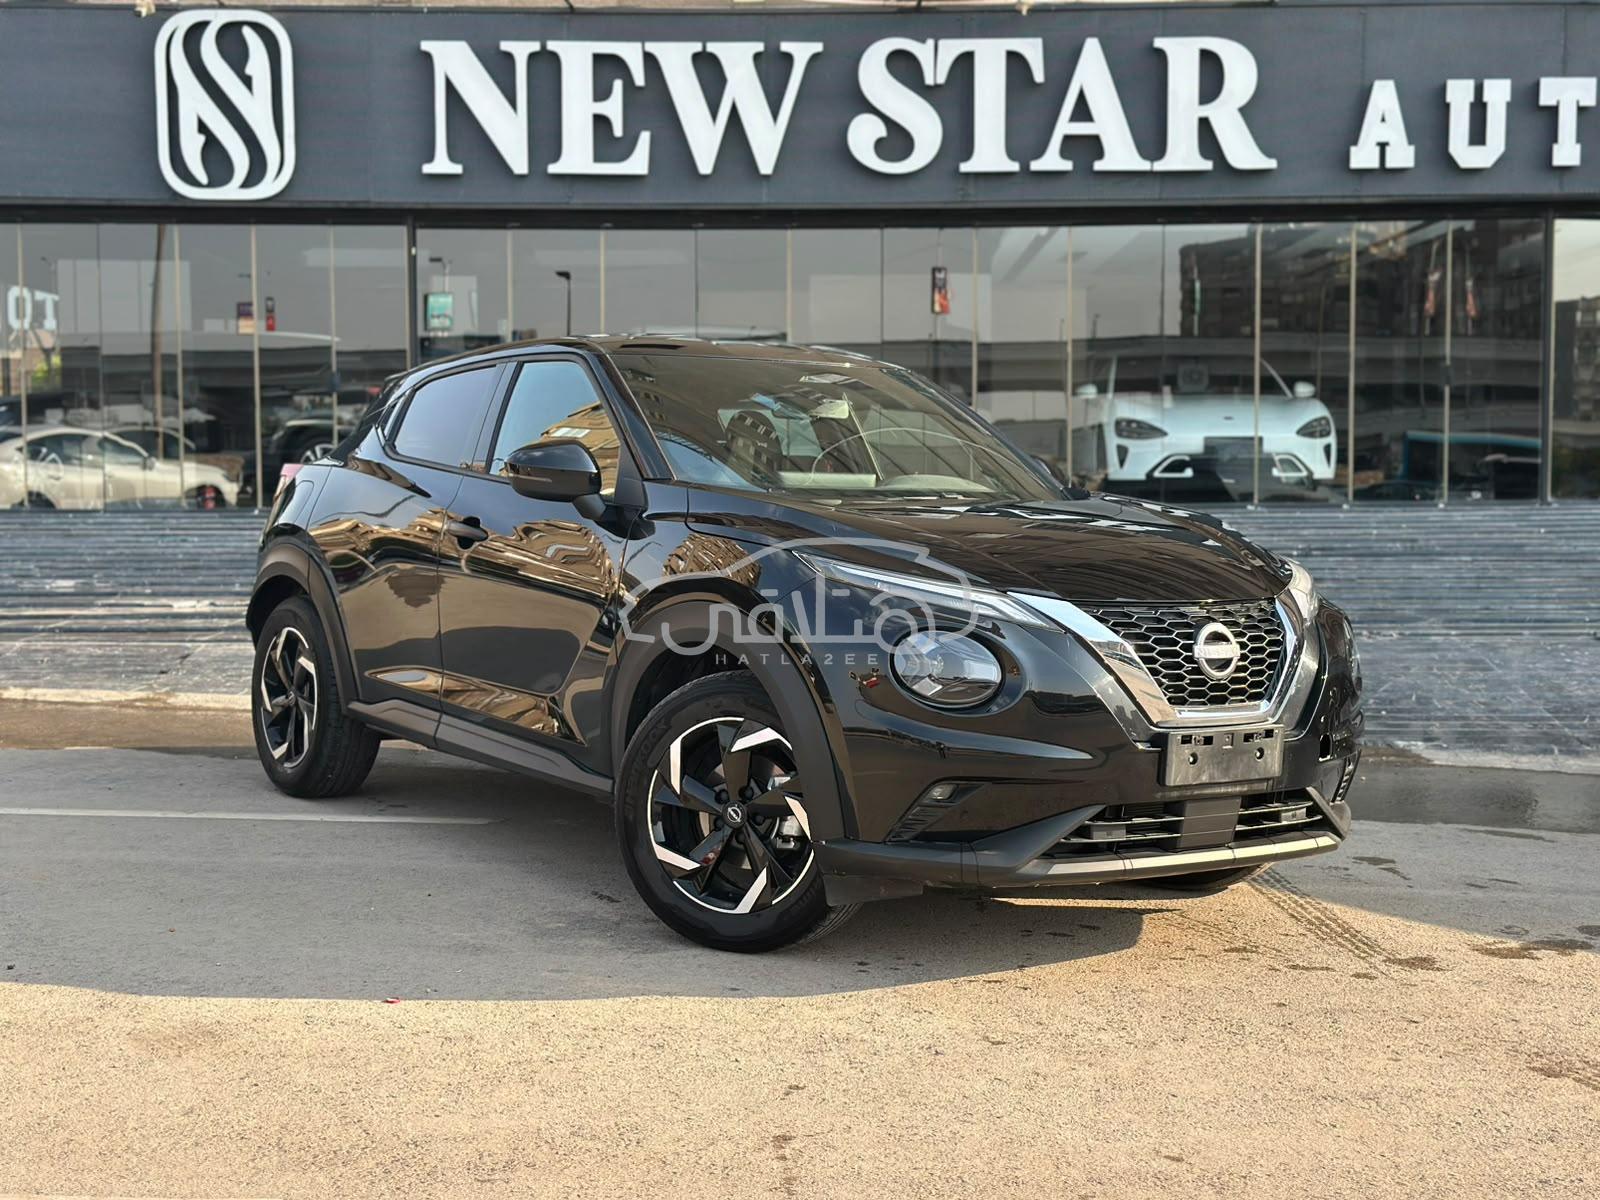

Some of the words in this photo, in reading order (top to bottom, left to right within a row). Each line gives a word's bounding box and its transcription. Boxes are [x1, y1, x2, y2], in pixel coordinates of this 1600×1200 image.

[420, 39, 823, 174] NEW
[847, 36, 1278, 175] STAR
[1349, 77, 1597, 169] AUT
